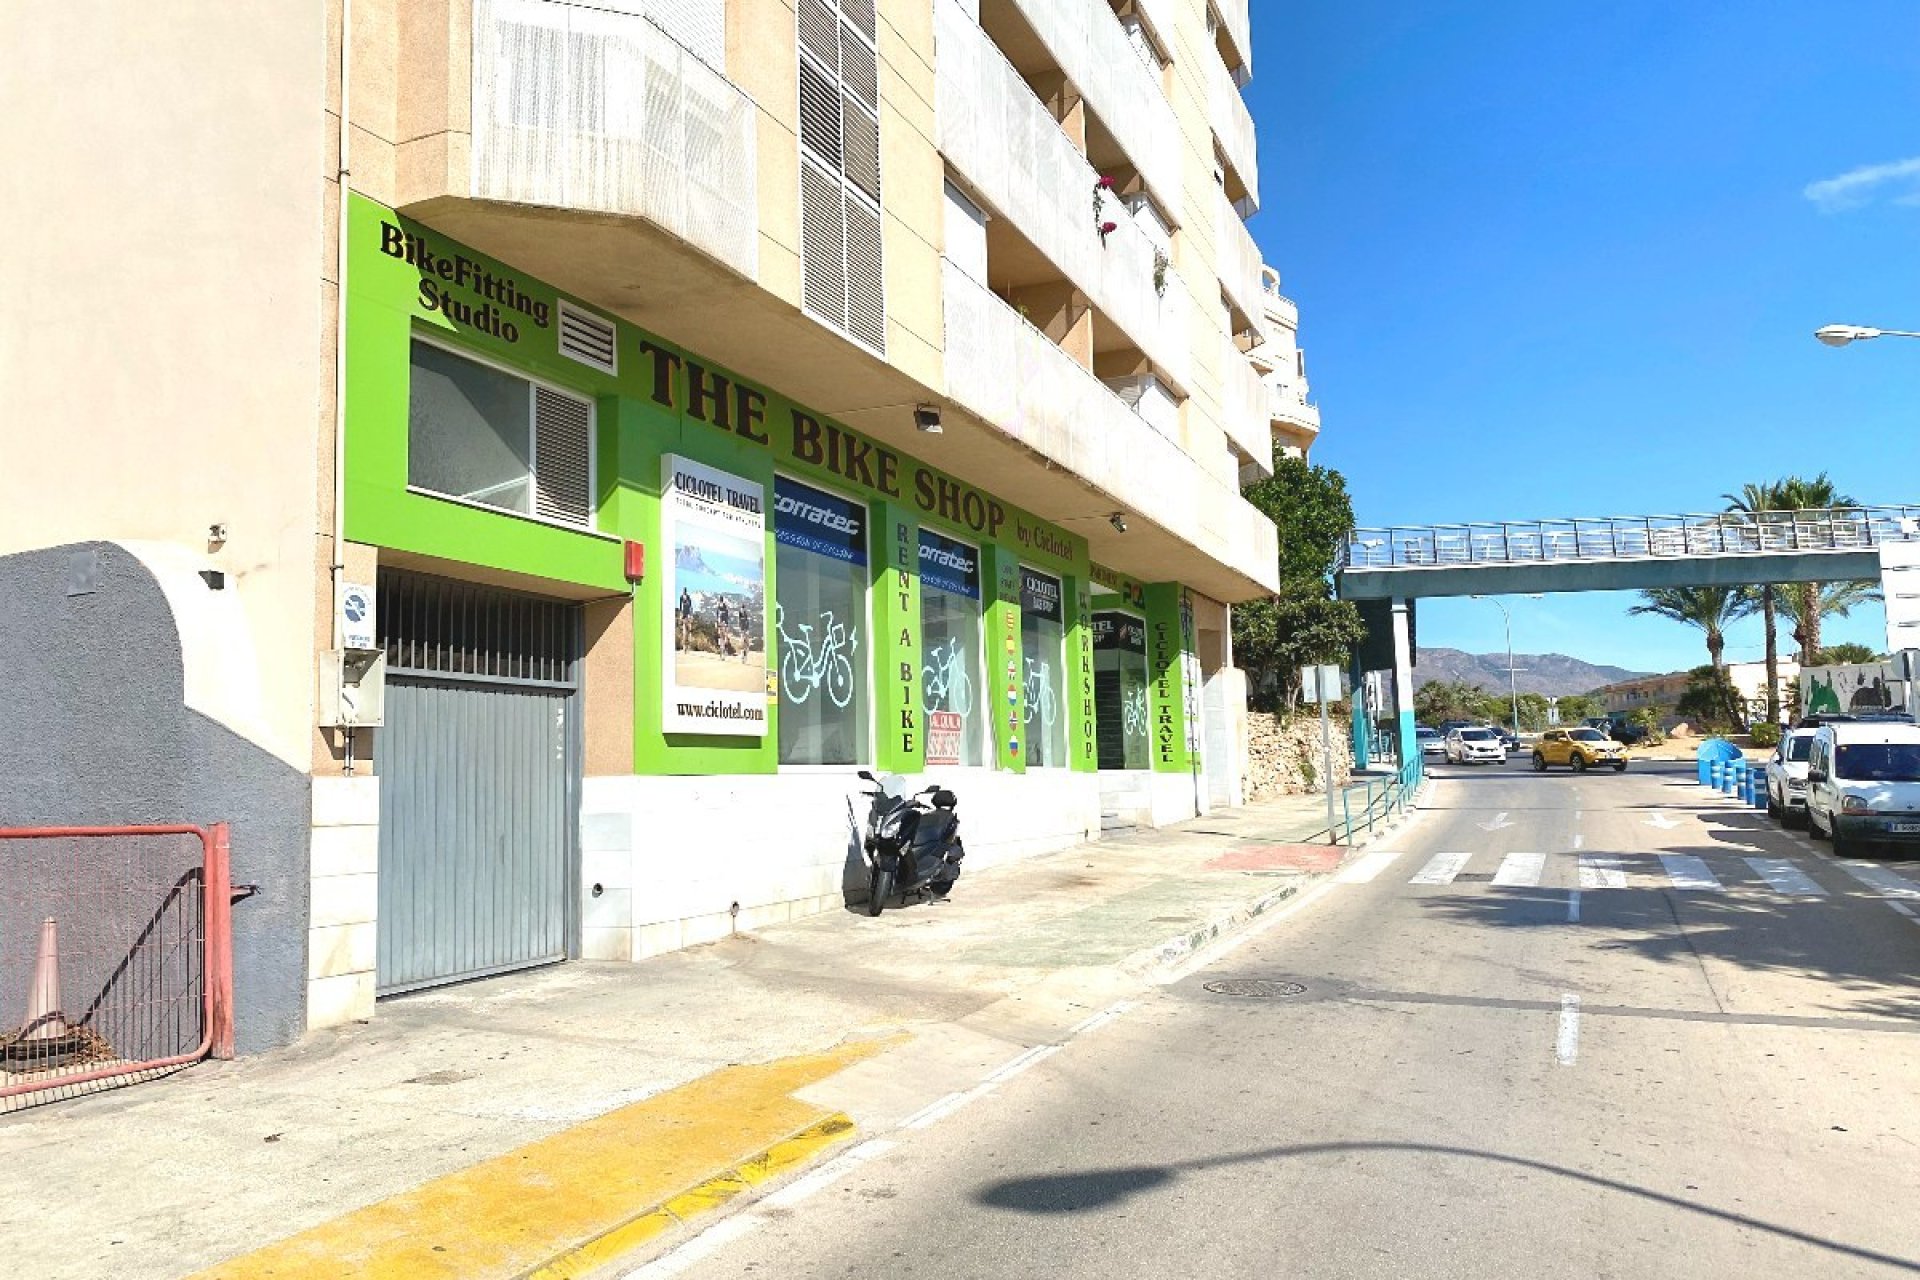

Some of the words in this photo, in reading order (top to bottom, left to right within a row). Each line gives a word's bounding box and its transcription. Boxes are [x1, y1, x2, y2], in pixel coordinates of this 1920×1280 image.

[380, 220, 550, 329] BikeFitting
[418, 278, 520, 345] Studio
[639, 339, 770, 446] THE
[791, 408, 901, 500] BIKE
[913, 467, 1006, 539] SHOP
[1016, 520, 1032, 548] by
[1034, 526, 1074, 562] Ciclotel
[675, 471, 724, 503] CICLOTEL
[726, 487, 761, 514] TRAVEL
[896, 522, 912, 613] RENT
[918, 544, 974, 574] orratec
[1026, 576, 1059, 599] CICLOTEL
[898, 627, 912, 648] A
[1155, 621, 1172, 699] CICLOTEL
[676, 701, 764, 721] www.ciclotel.com
[899, 661, 915, 754] BIKE
[1158, 704, 1175, 764] TRAVEL
